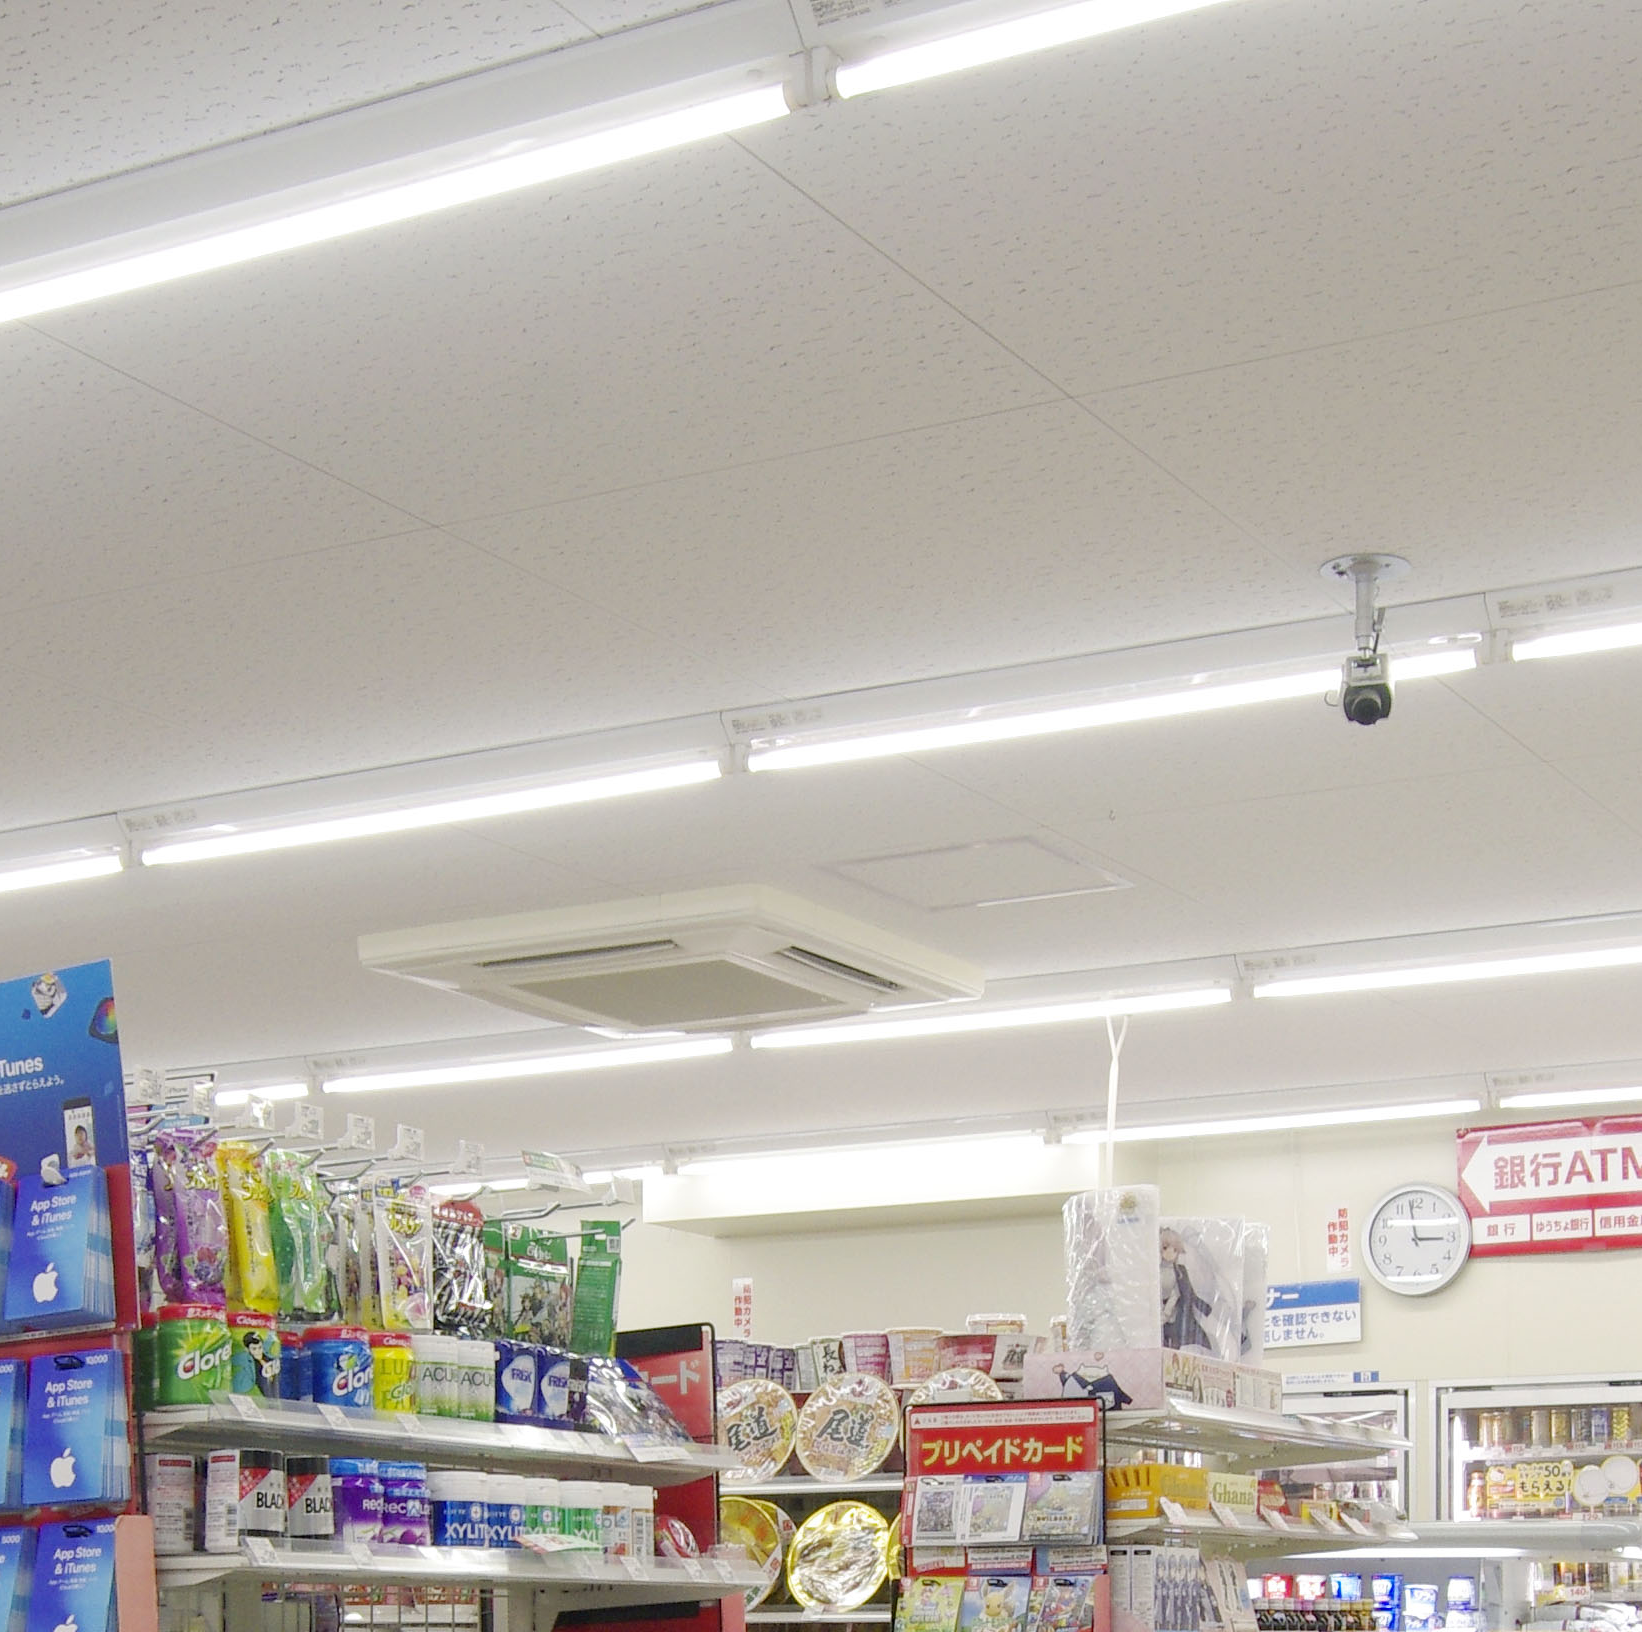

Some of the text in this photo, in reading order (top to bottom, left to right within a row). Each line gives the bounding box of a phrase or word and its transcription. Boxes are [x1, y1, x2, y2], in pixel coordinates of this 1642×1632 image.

[30, 1194, 78, 1213] App Store
[31, 1210, 73, 1226] & iTunes
[1534, 1216, 1591, 1234] ゆうちょ銀行
[1327, 1221, 1339, 1258] 作動中
[1338, 1207, 1350, 1269] 防犯カメラ
[1378, 1235, 1388, 1248] 9
[44, 1377, 94, 1395] App Store
[46, 1392, 89, 1408] & iTunes
[726, 1405, 778, 1452] 尾道
[816, 1408, 875, 1450] 尾道
[921, 1435, 1084, 1467] プリペイドカード
[1212, 1481, 1255, 1507] Ghana
[53, 1545, 102, 1564] App Store
[55, 1559, 97, 1576] & iTunes
